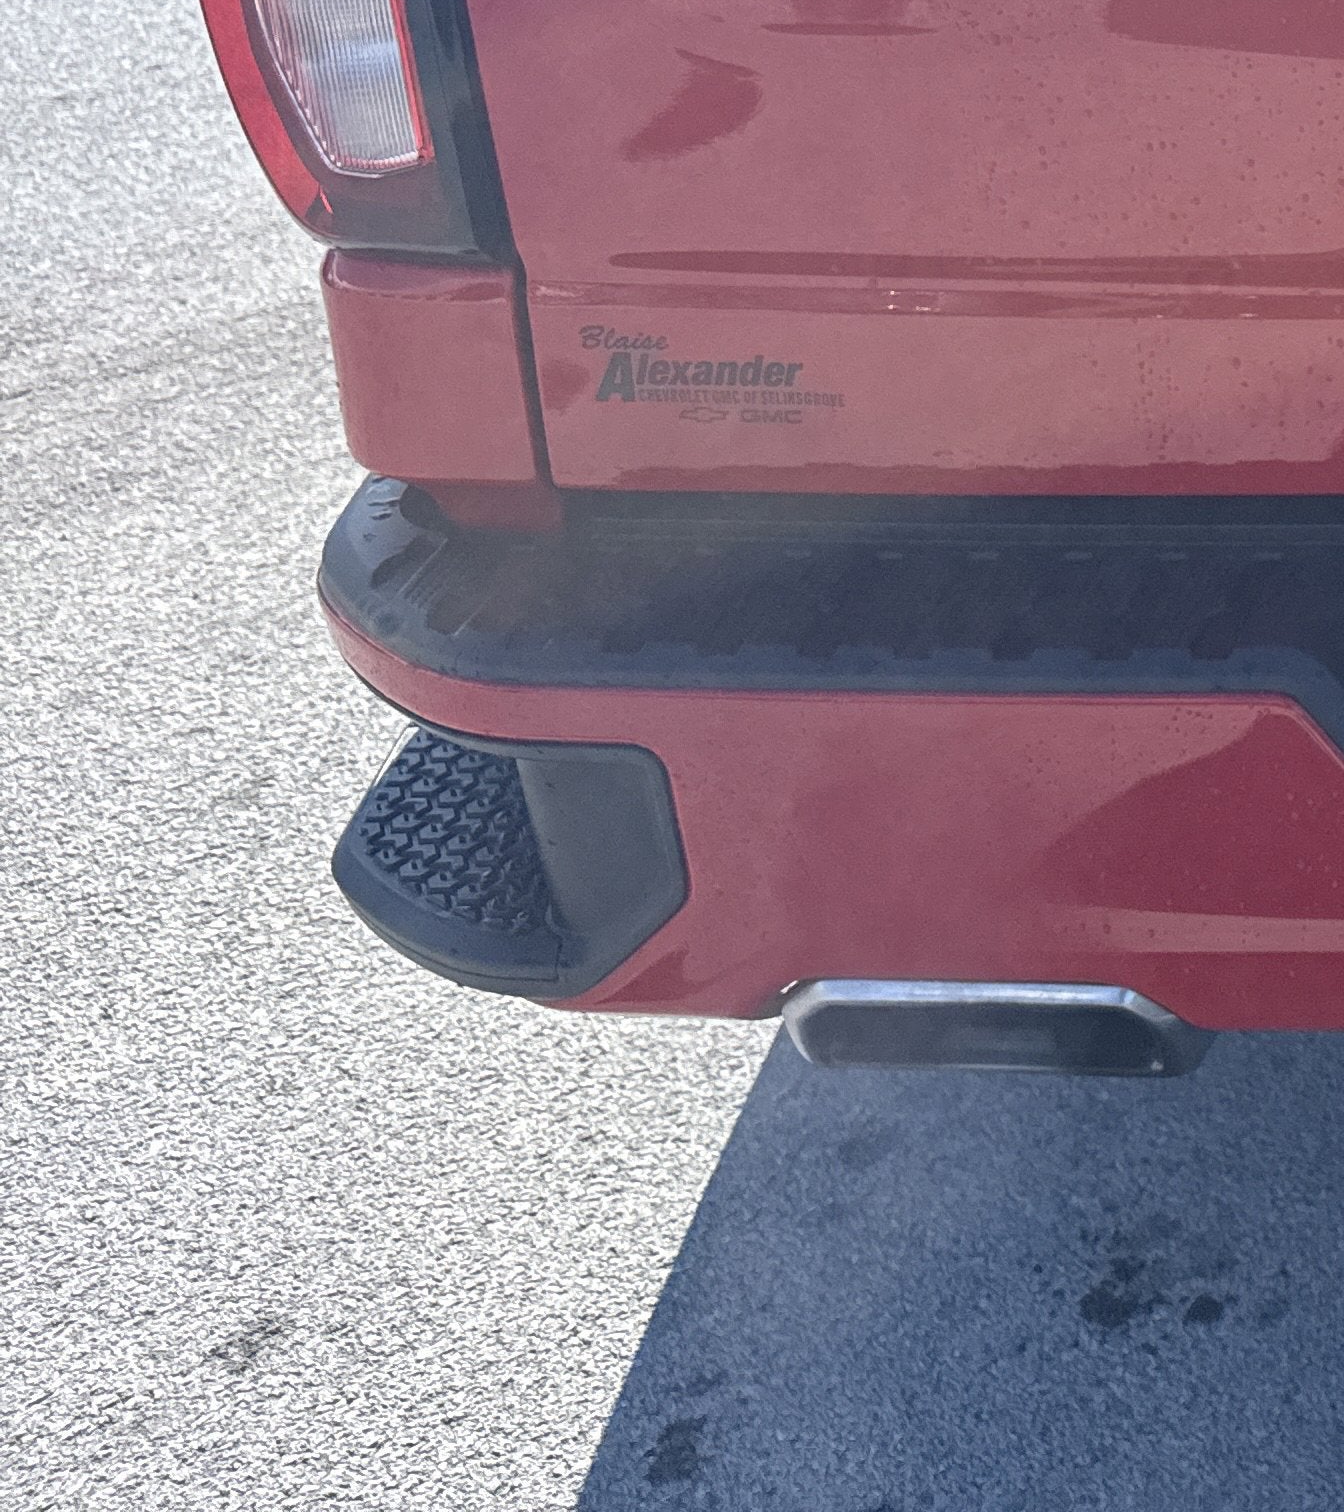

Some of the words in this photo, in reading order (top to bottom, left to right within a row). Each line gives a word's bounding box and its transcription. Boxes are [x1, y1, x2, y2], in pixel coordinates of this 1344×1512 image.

[579, 324, 669, 350] Blaise
[595, 351, 804, 403] Alexander
[740, 409, 802, 424] GMC
